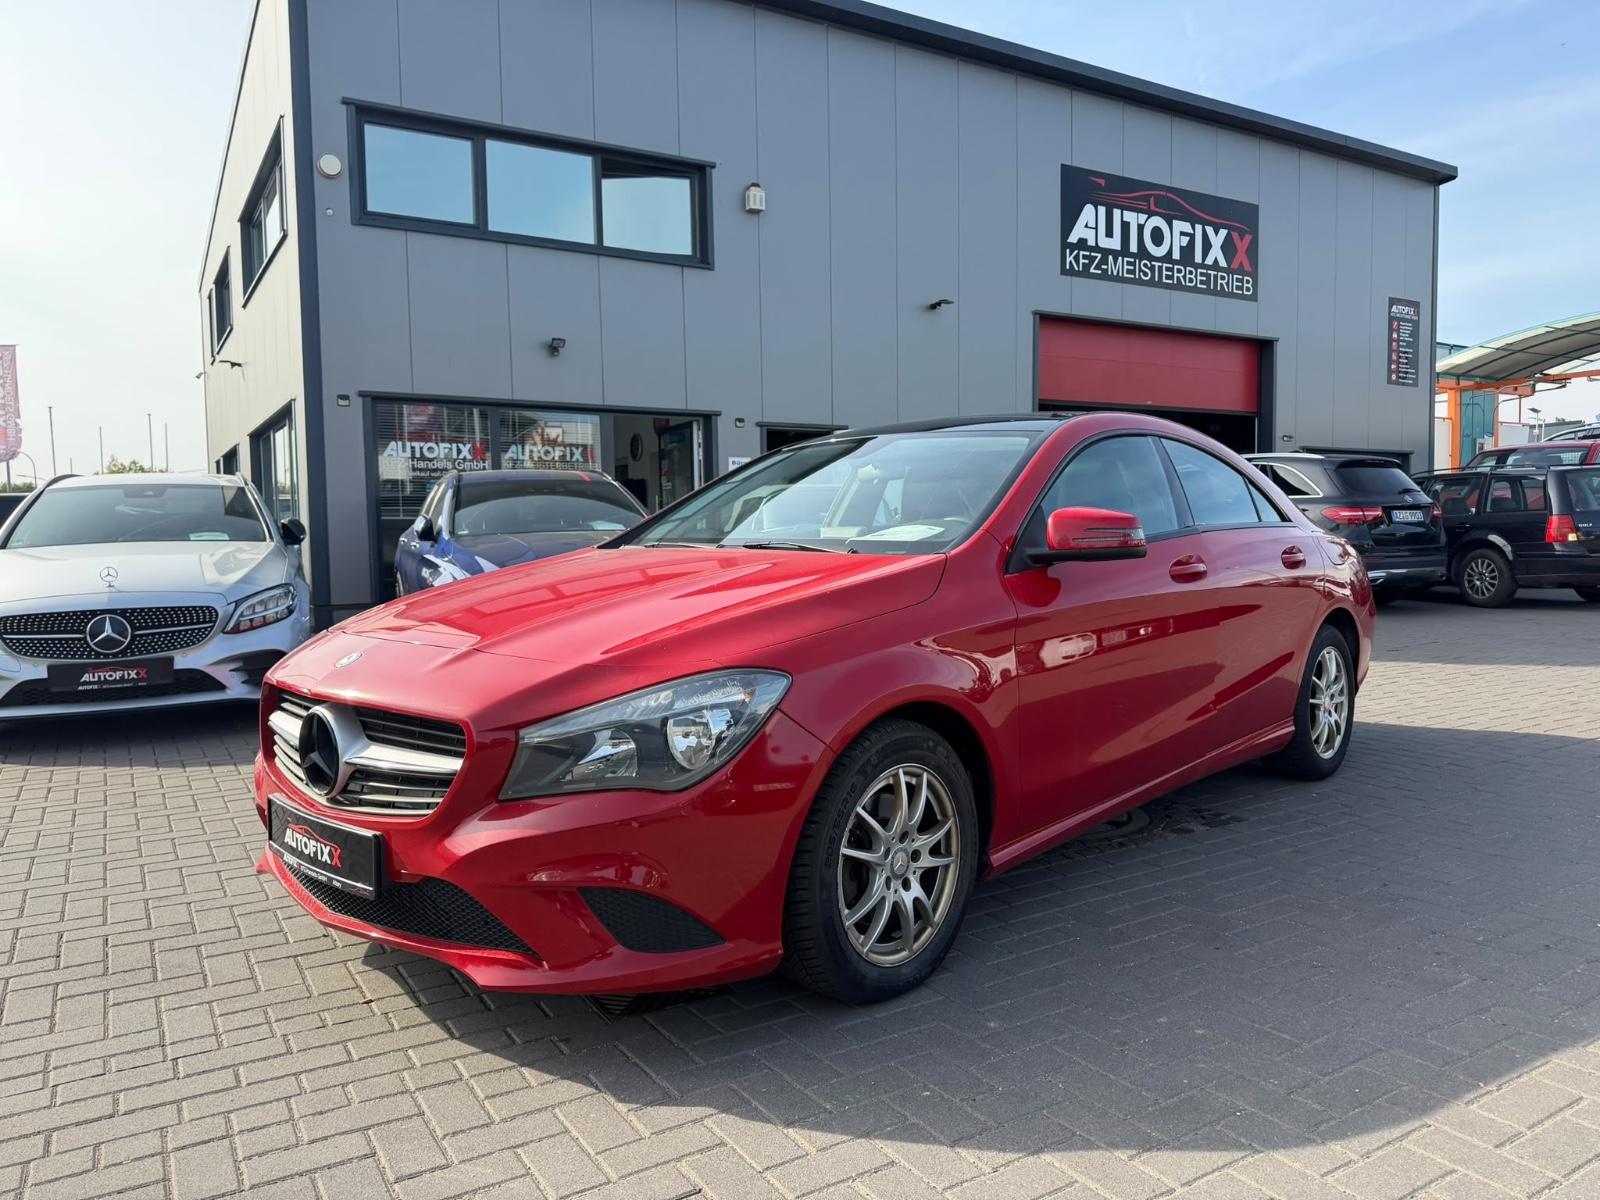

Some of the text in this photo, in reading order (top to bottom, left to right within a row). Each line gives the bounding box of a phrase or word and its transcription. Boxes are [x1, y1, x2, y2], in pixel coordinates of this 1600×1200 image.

[1066, 203, 1254, 272] AUTOFIXX
[1065, 248, 1253, 295] KFZ-MEISTERBETRIEB
[383, 440, 487, 461] AUTOFIXX
[455, 459, 489, 470] GmbH
[80, 670, 147, 682] AUTOFIXX
[284, 827, 342, 868] AUTOFIXX
